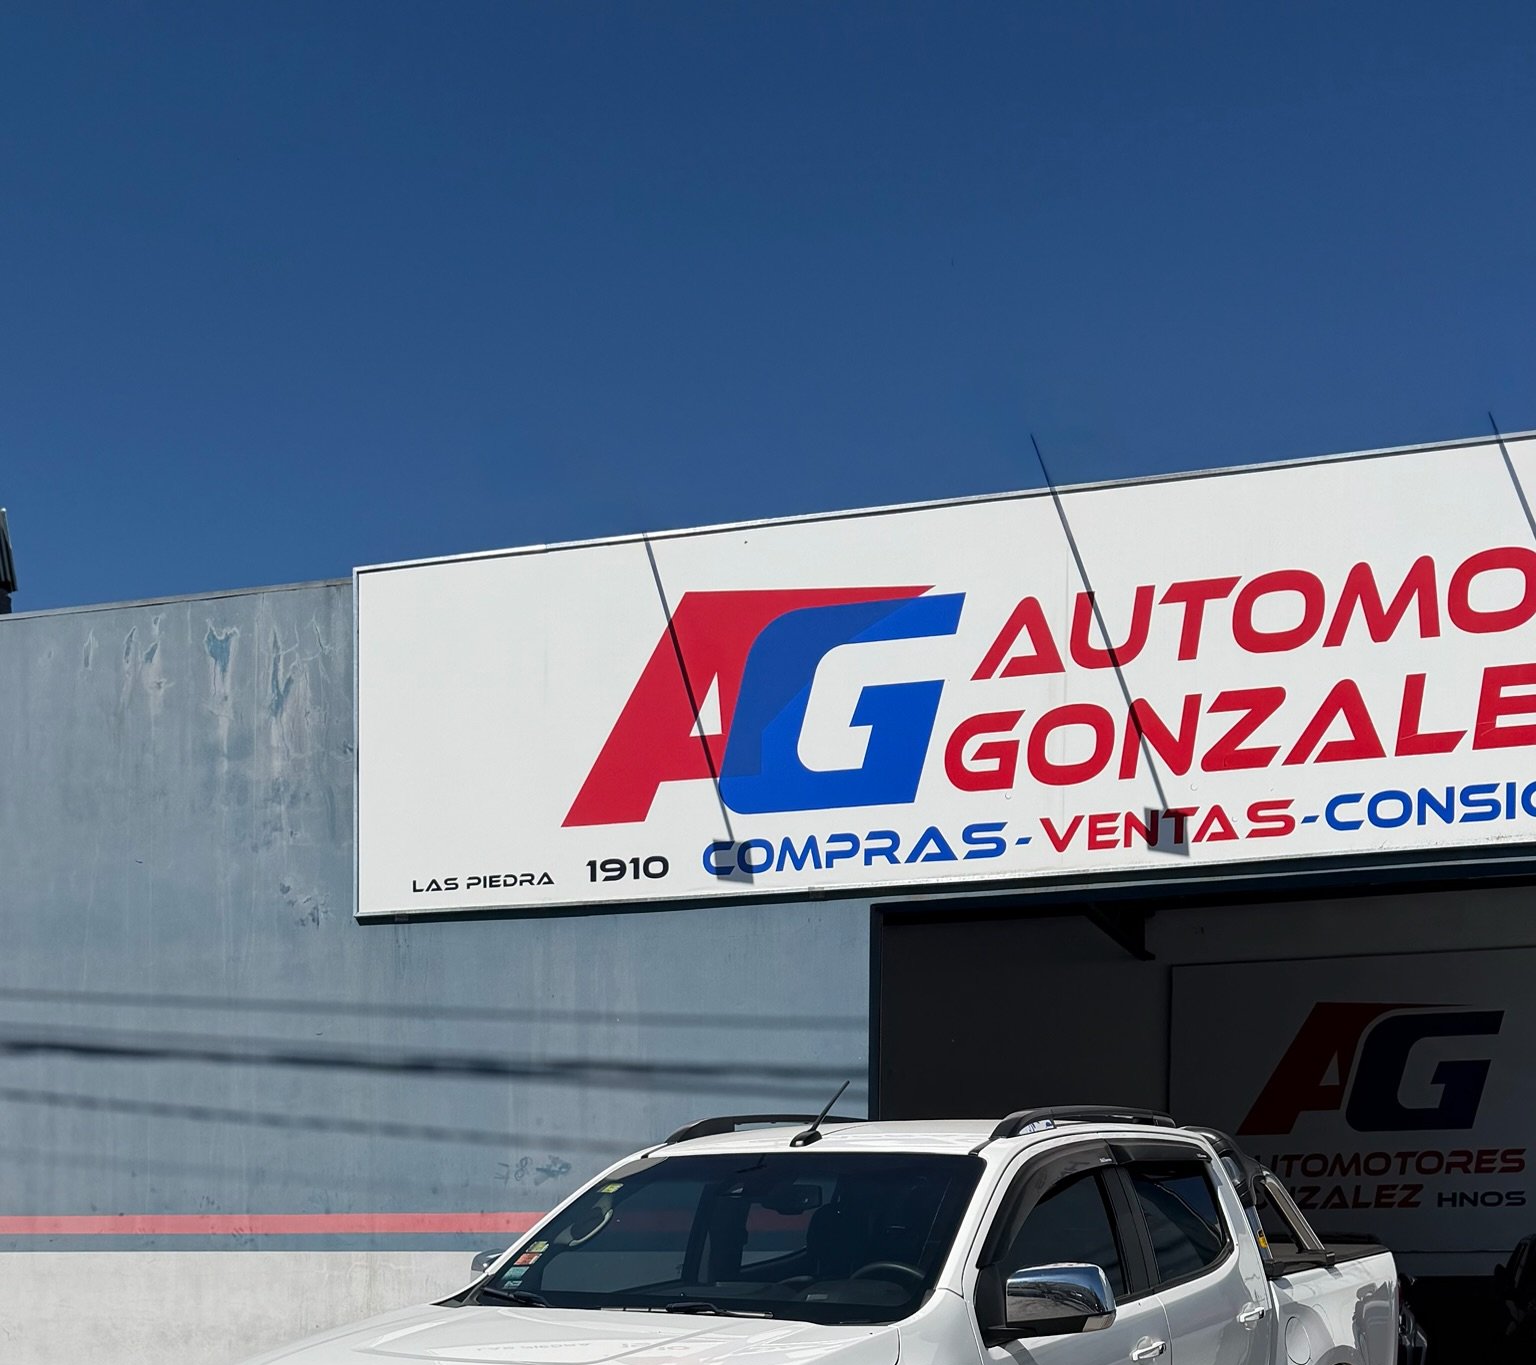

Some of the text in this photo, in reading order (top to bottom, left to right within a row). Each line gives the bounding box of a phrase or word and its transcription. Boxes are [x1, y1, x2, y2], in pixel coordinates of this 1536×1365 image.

[970, 546, 1536, 681] AUTOMO
[560, 585, 966, 828] AG
[944, 663, 1536, 792] GONZALE
[412, 855, 670, 893] LAS PIEDRA 1910
[1235, 1001, 1505, 1136] AG
[1437, 1190, 1527, 1208] HNOS
